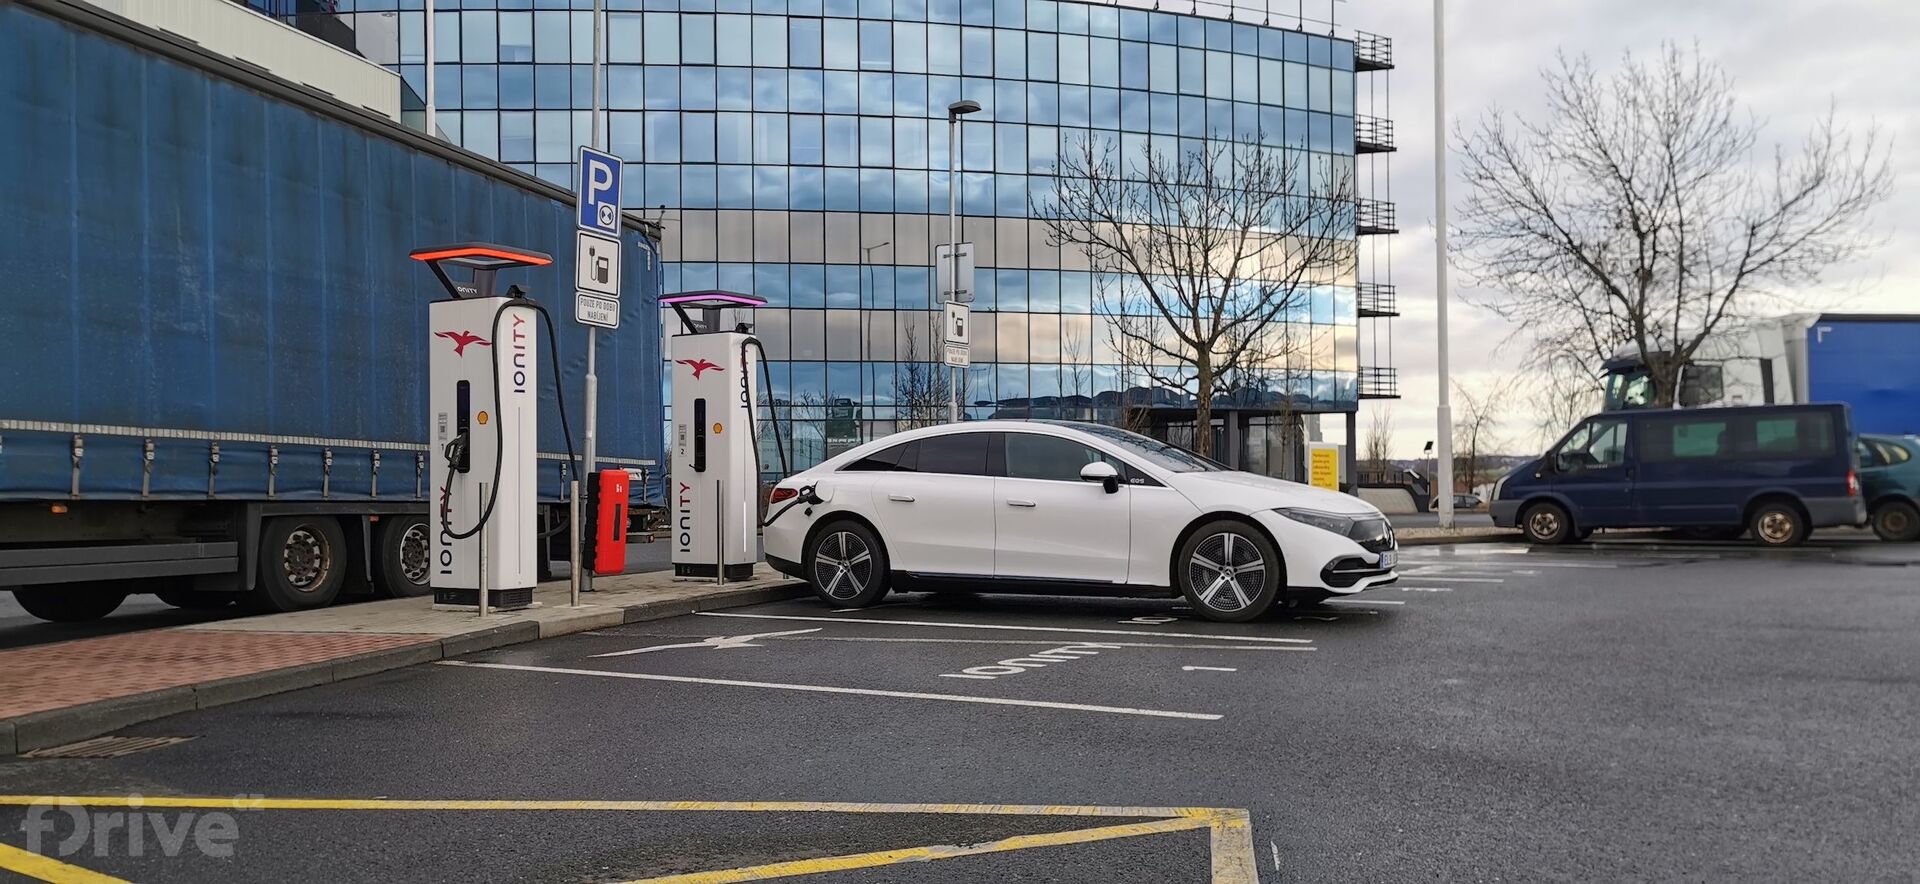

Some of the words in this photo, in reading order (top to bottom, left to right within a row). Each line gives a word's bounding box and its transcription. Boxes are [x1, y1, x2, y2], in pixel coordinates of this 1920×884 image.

[588, 159, 613, 206] P
[580, 297, 595, 308] POUZE
[596, 300, 602, 310] PO
[603, 302, 616, 312] DOBU
[513, 313, 526, 393] IONITY
[680, 482, 691, 553] IONITY
[938, 642, 1121, 680] IONITY
